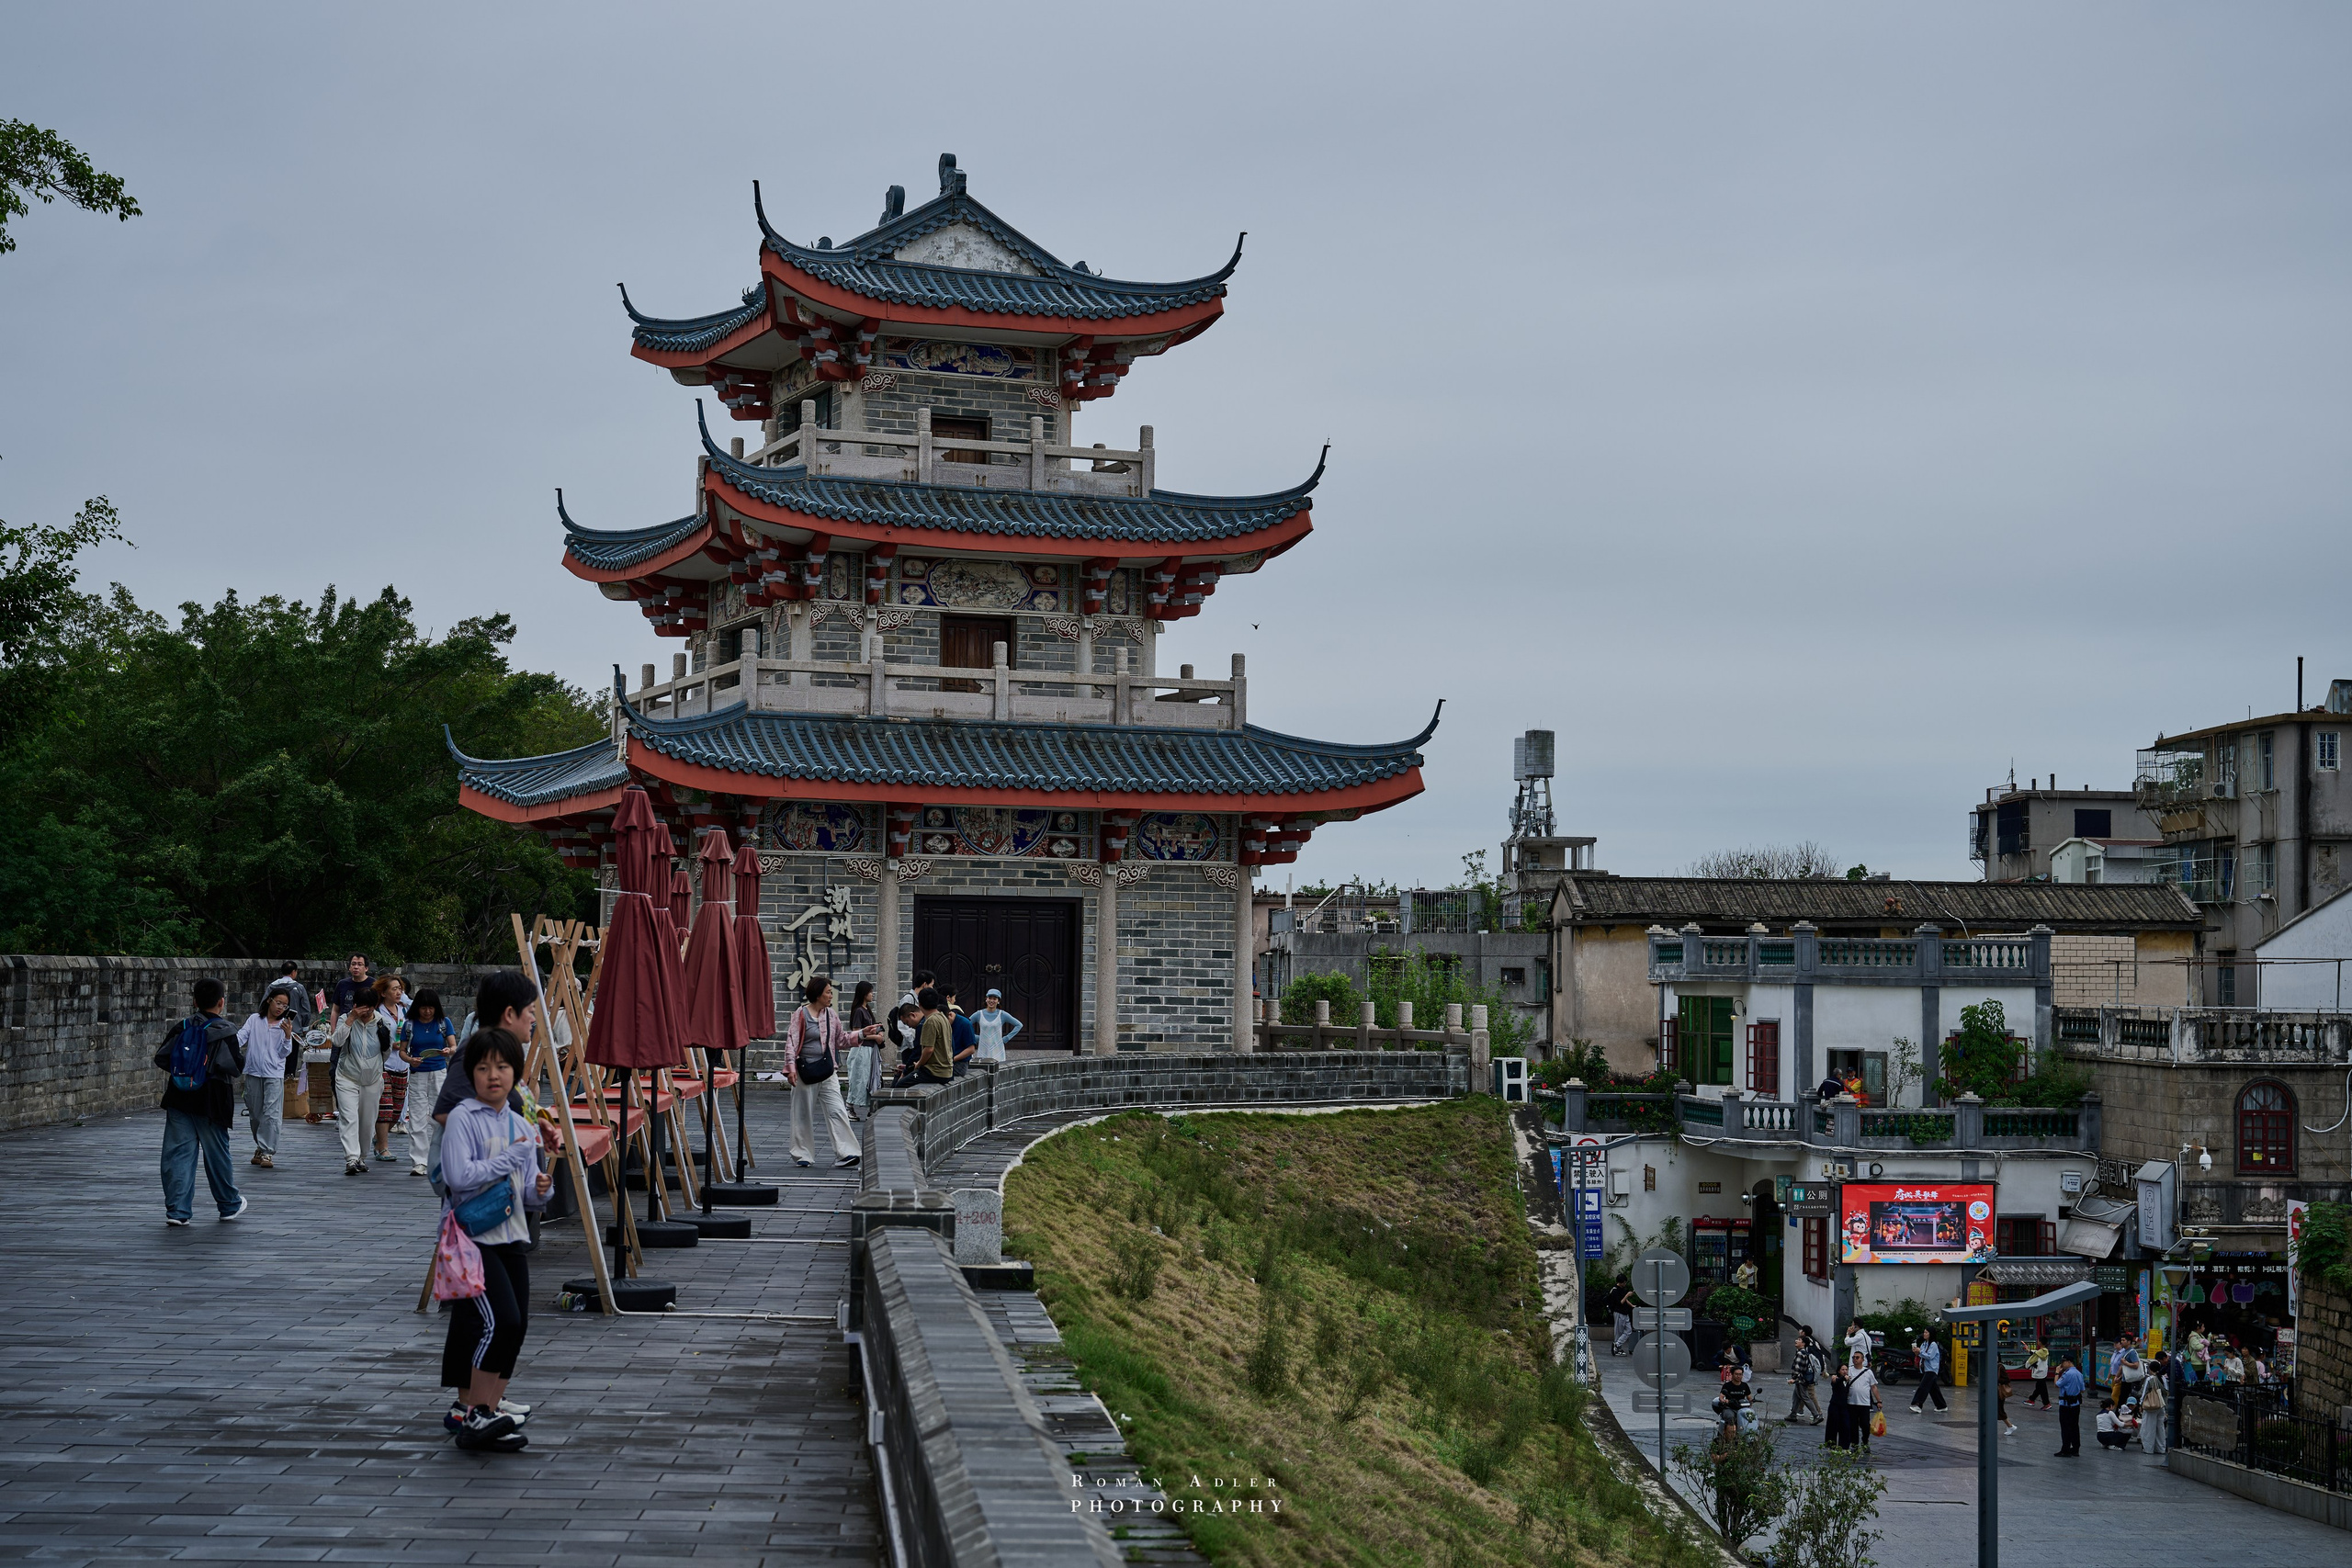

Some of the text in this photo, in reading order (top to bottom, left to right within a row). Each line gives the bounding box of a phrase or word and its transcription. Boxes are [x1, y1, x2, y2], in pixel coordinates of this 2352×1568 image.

[824, 884, 854, 941] 潮州
[1574, 1169, 1604, 1179] 禁驶入
[1807, 1190, 1828, 1201] 公厕
[1970, 1285, 1994, 1297] 雪糕
